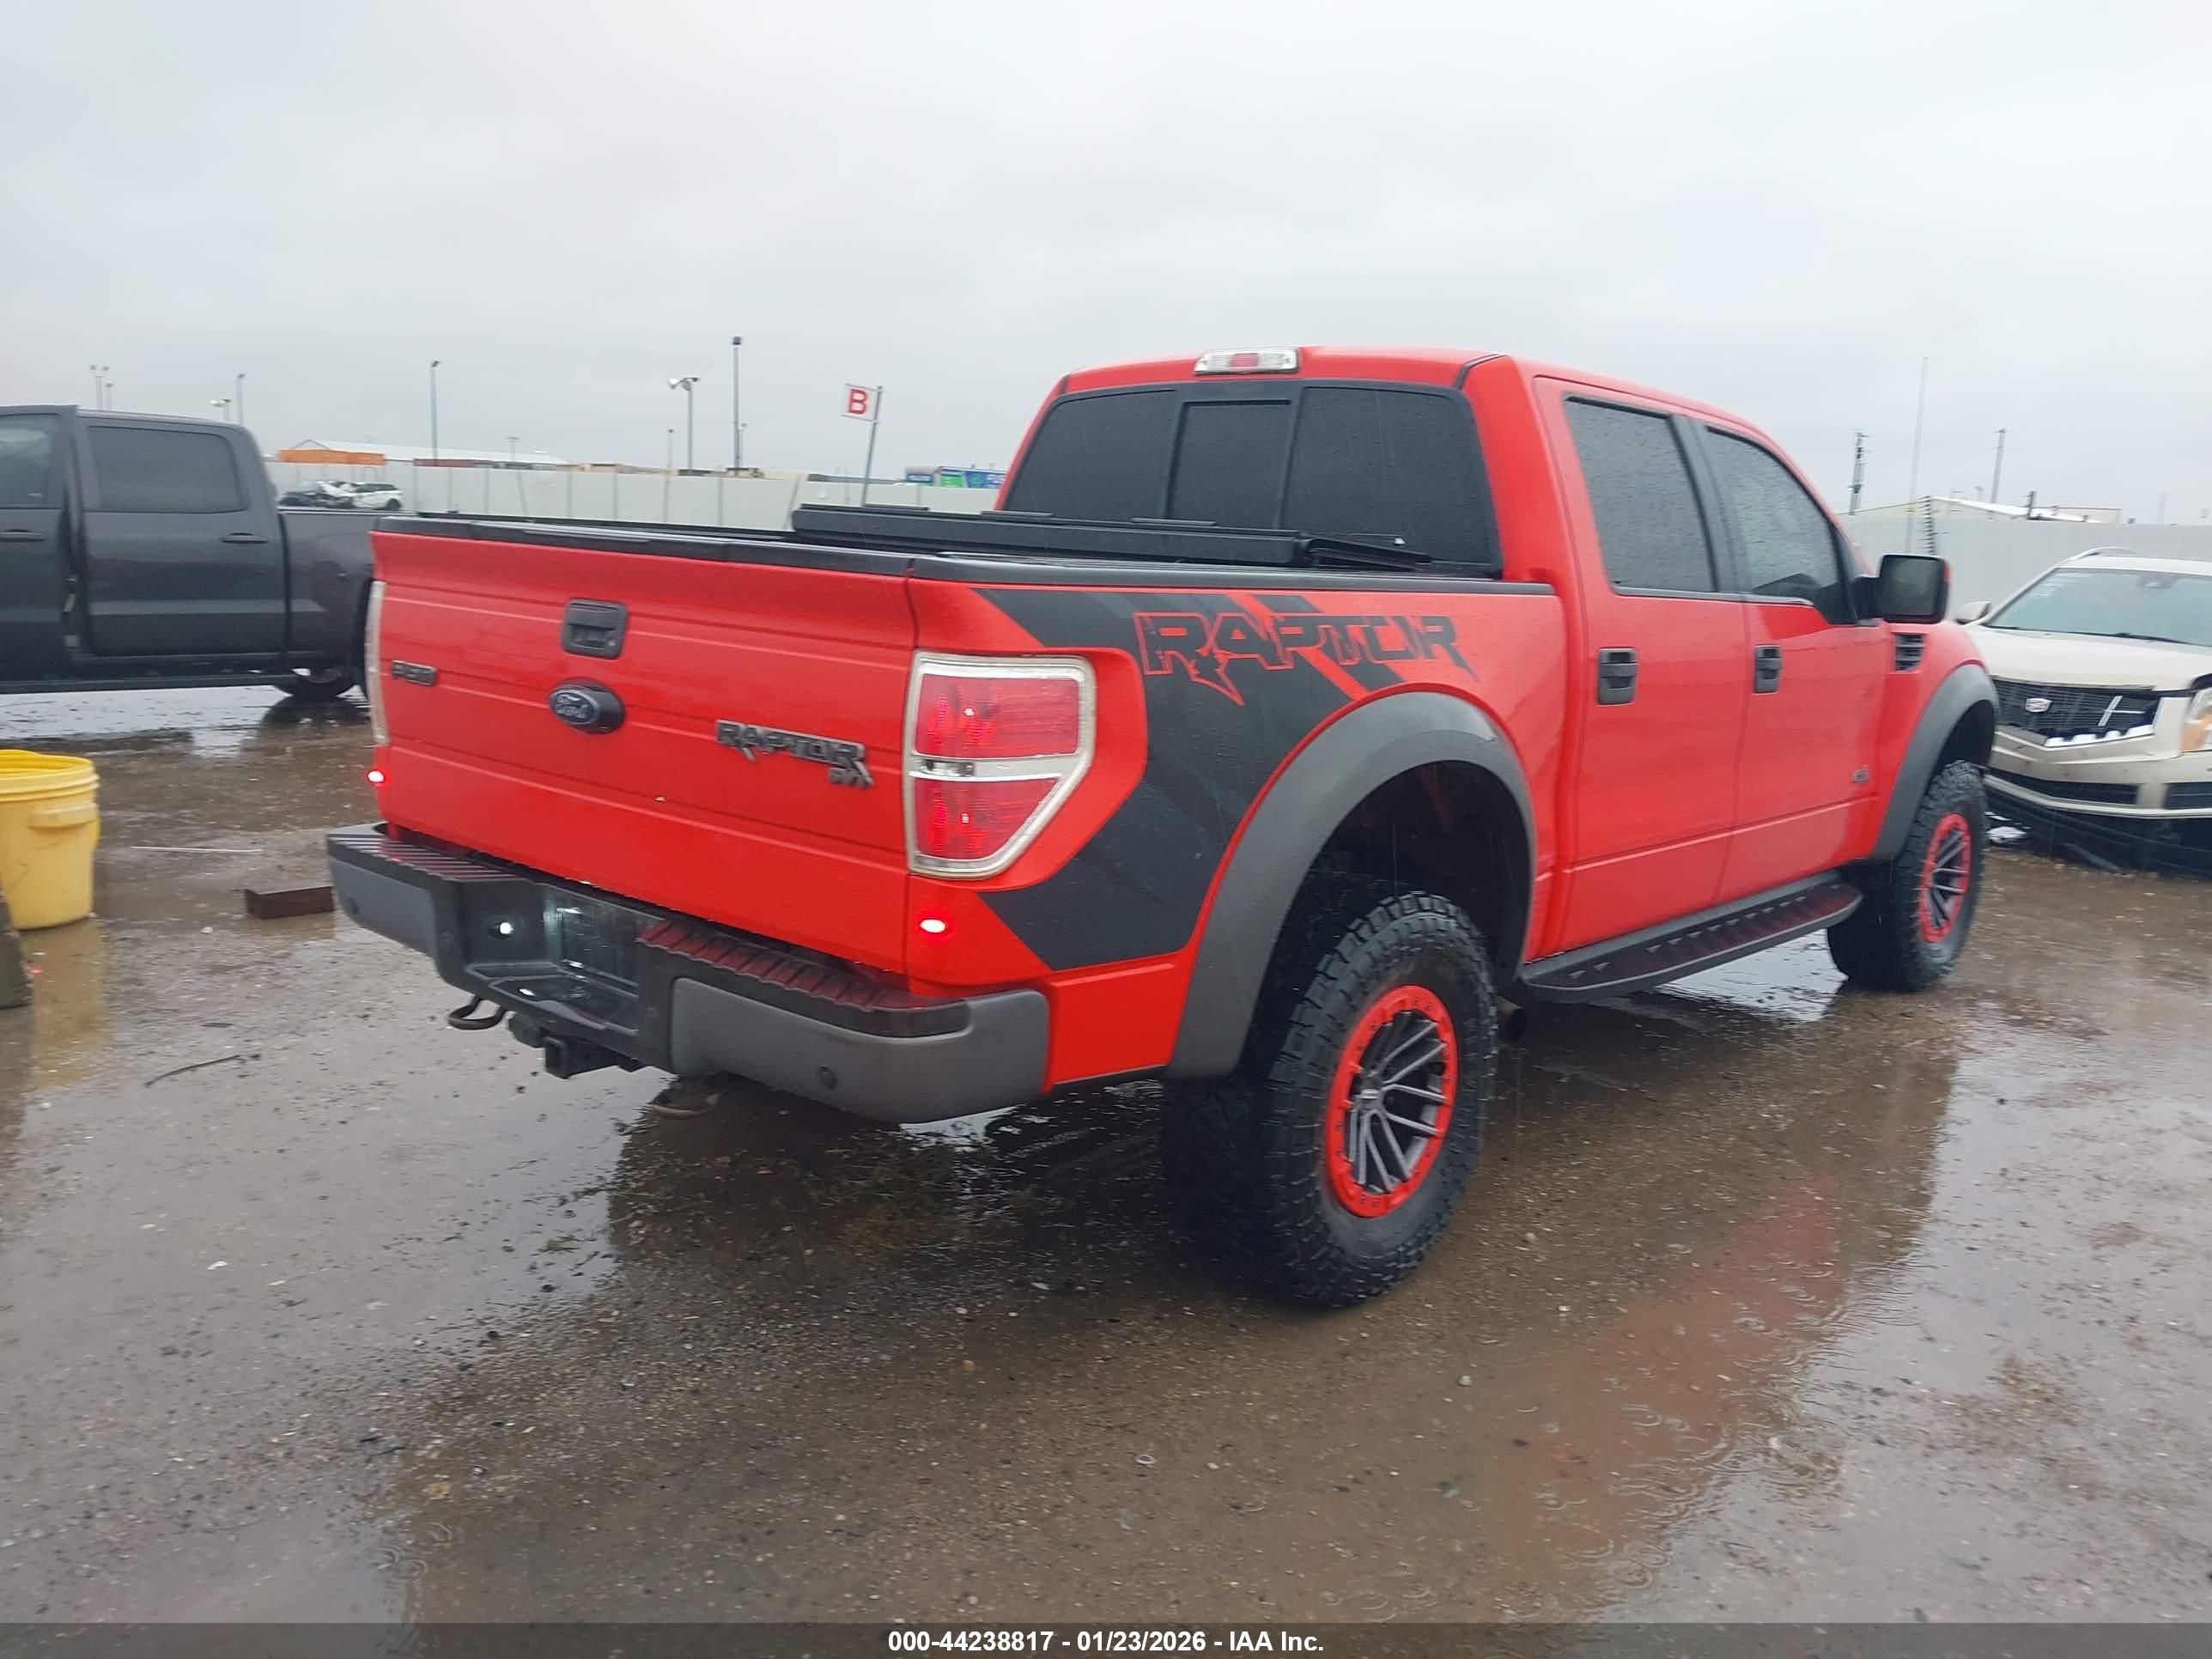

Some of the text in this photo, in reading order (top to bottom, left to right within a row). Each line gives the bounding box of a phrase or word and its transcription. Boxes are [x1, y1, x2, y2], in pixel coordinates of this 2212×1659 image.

[848, 388, 866, 415] B
[1133, 611, 1480, 706] RAPTOR
[555, 694, 592, 719] Ford
[715, 719, 874, 785] RAPTOR
